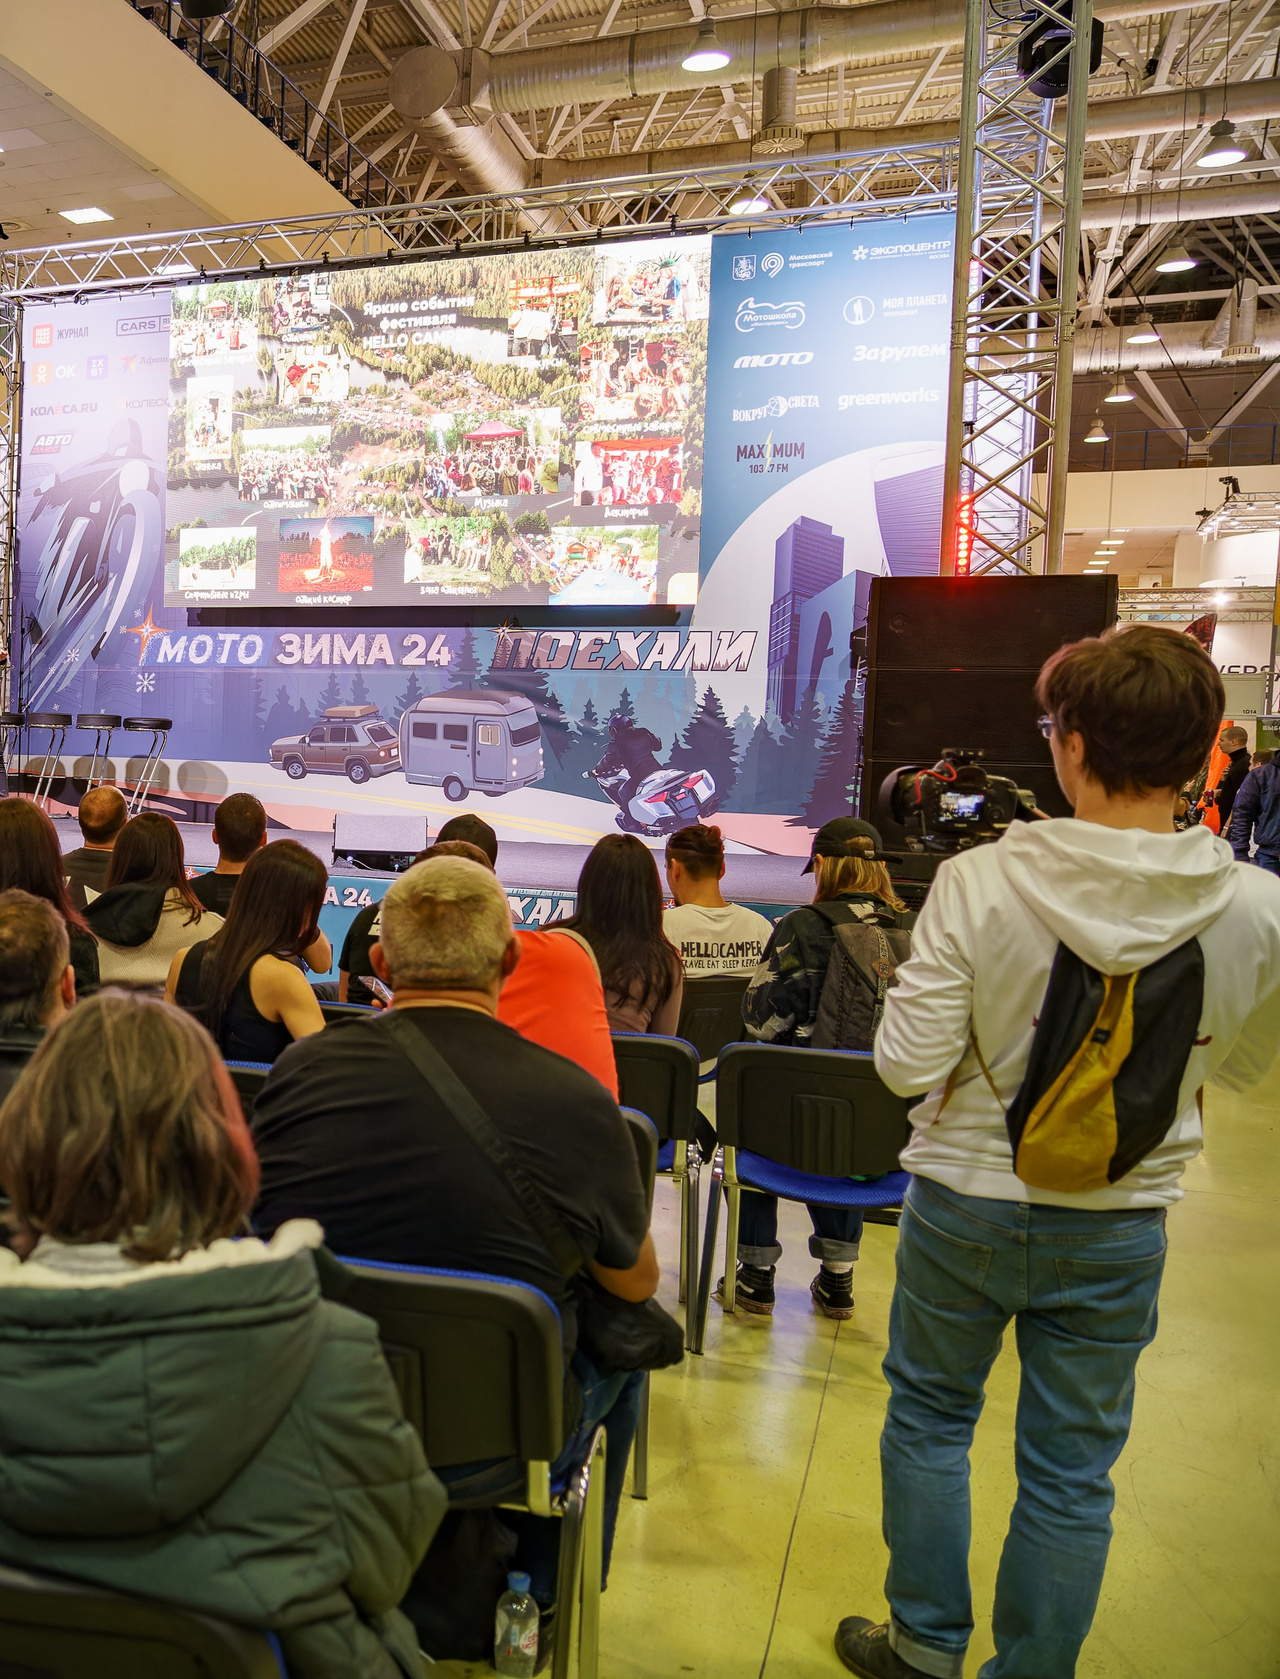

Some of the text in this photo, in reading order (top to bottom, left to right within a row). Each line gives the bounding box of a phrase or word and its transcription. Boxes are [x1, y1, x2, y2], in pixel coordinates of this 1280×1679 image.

[870, 240, 951, 255] ЭКСПОЦЕНТР
[789, 251, 833, 261] Московский
[789, 260, 825, 269] транспорт
[363, 295, 476, 318] Яркие события
[882, 293, 948, 309] МОЯ ПЛАНЕТА
[743, 312, 797, 323] Мотошкола
[883, 309, 918, 317] телеканал
[121, 320, 156, 332] CARS
[379, 313, 457, 333] фестиваля
[57, 326, 89, 340] ЖУРНАЛ
[363, 334, 409, 350] HELLO
[838, 387, 940, 411] greenworks
[732, 394, 820, 422] ВОКРУГ СВЕТА
[35, 435, 72, 447] АВТО
[32, 446, 59, 454] ПЛЮС
[776, 463, 789, 473] FM
[156, 633, 453, 667] МОТО ЗИМА 24
[490, 630, 758, 671] ПОЕХАЛИ
[343, 887, 372, 908] 24
[707, 960, 720, 969] EAT
[722, 960, 740, 969] SLEEP
[741, 959, 760, 967] REPEA
